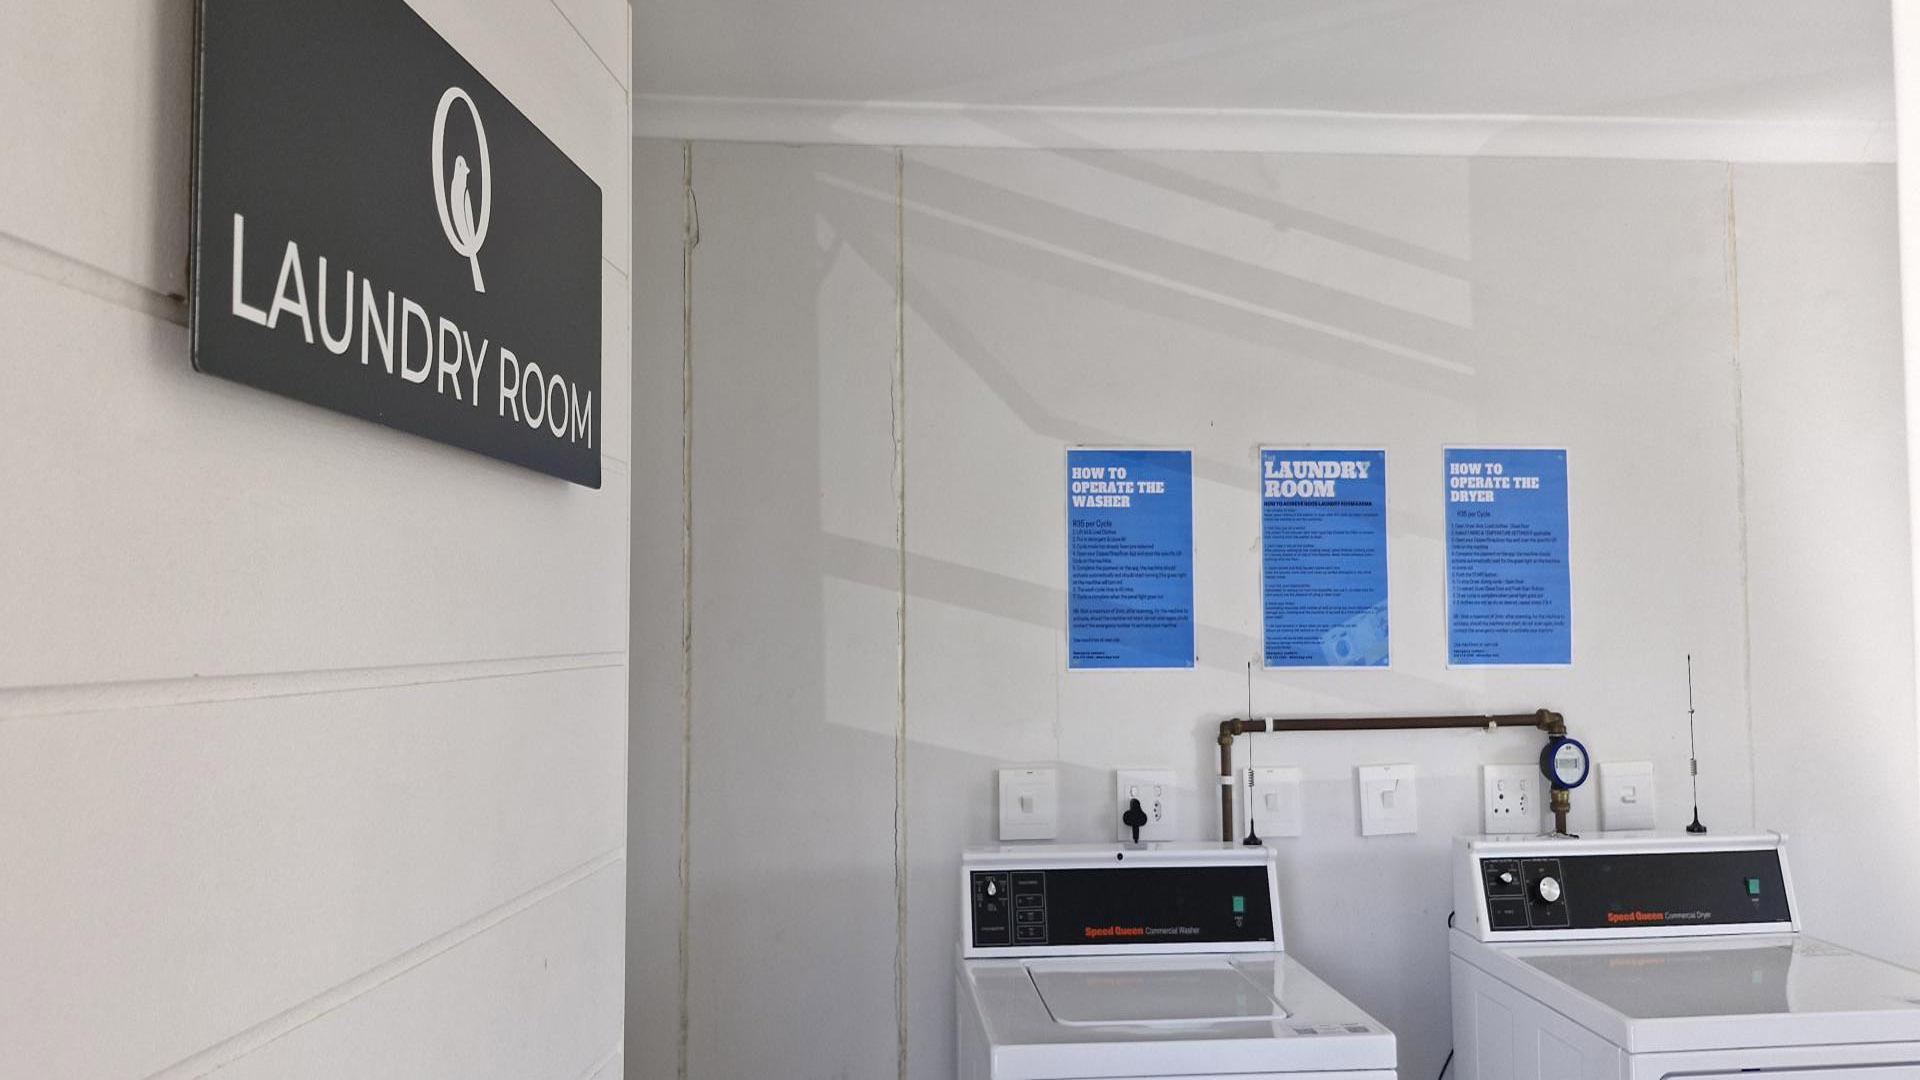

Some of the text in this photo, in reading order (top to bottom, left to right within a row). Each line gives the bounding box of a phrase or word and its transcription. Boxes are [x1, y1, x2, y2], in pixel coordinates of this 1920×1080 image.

[232, 213, 592, 449] LAUNDRY ROOM
[1072, 467, 1127, 480] HOW TO
[1264, 461, 1371, 479] LAUNDRY
[1450, 463, 1503, 475] HOW TO
[1072, 481, 1165, 493] OPERATE THE
[1264, 480, 1335, 497] ROOM
[1450, 477, 1540, 489] OPERATE THE
[1072, 495, 1131, 507] WASHER
[1450, 490, 1495, 502] DRYER
[1096, 519, 1112, 528] Cycle
[1608, 912, 1635, 923] Speed
[1635, 911, 1664, 920] Queen
[1085, 926, 1200, 937] Speed Queen Commercial Washer
